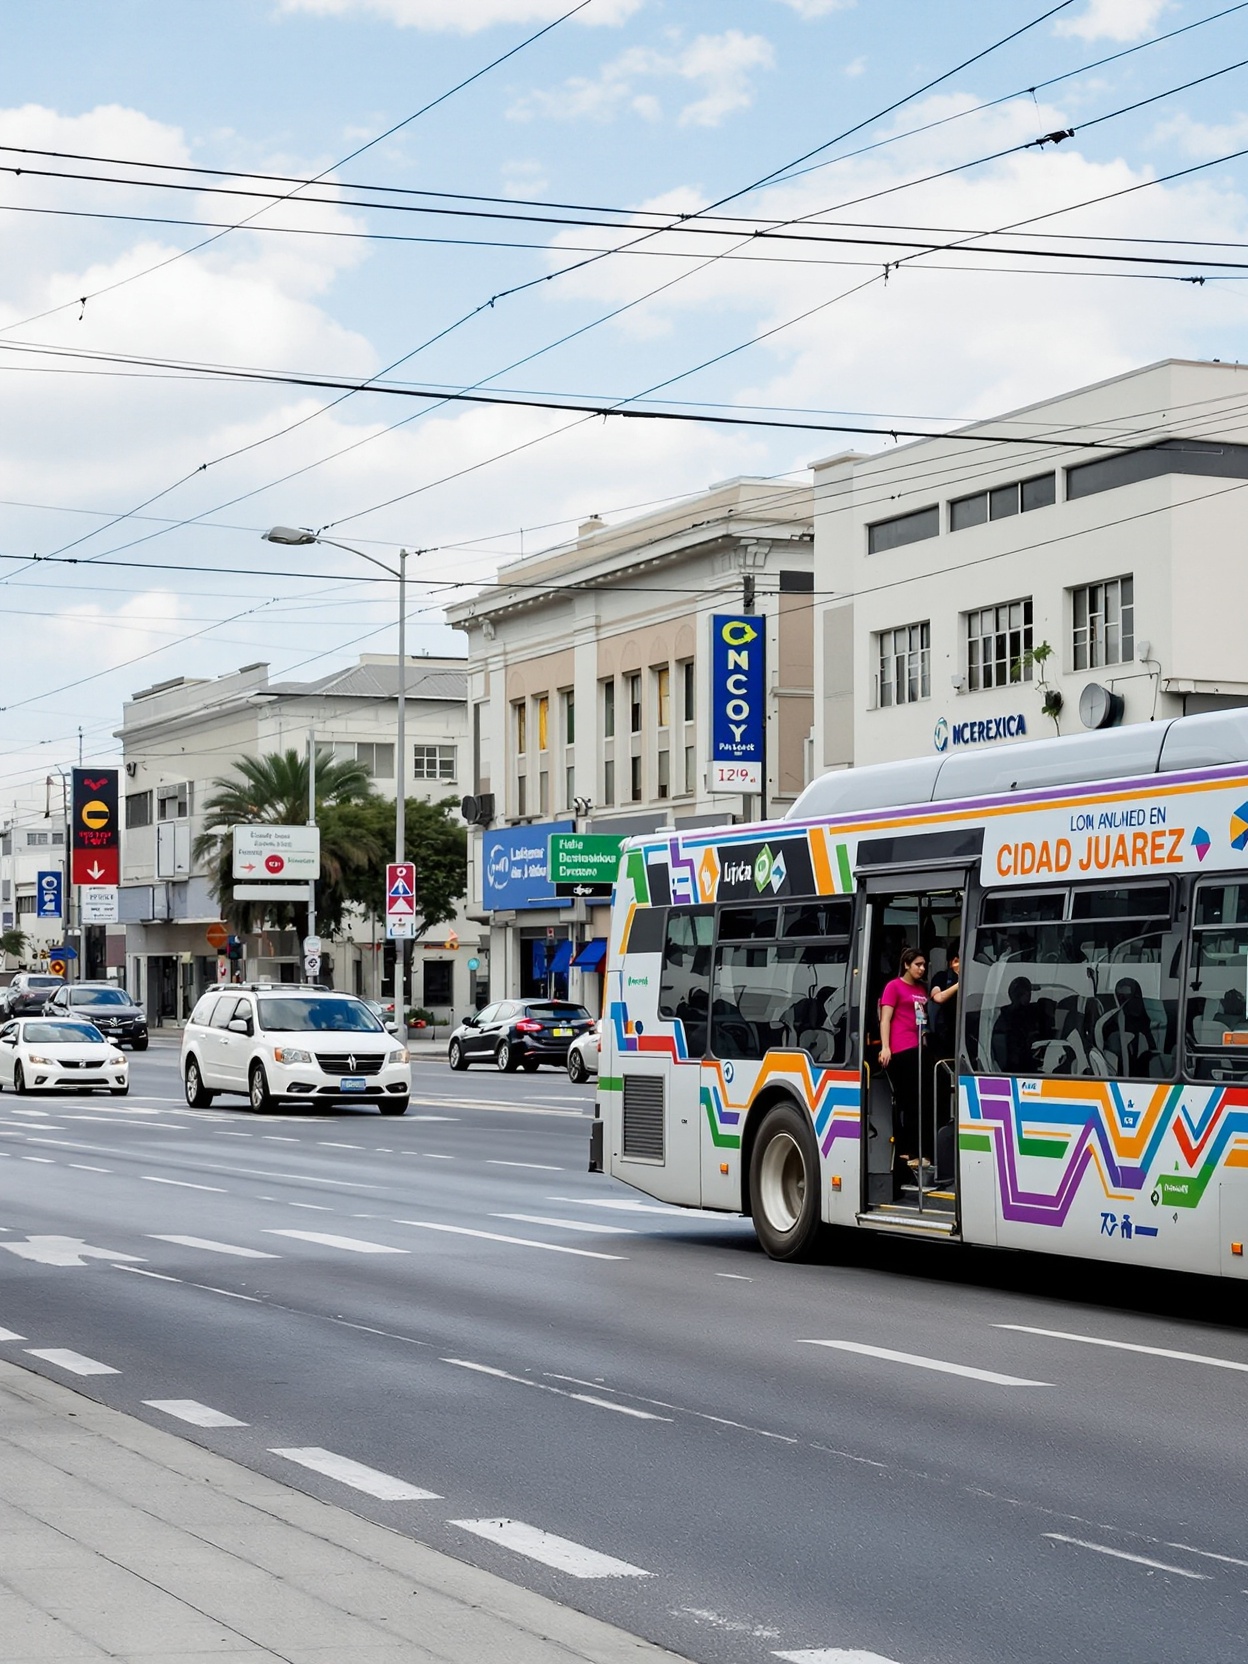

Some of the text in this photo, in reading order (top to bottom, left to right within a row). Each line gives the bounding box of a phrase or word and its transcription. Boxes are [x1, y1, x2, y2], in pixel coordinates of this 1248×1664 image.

[1149, 805, 1167, 825] EN
[996, 828, 1185, 877] CIDAD JUAREZ
